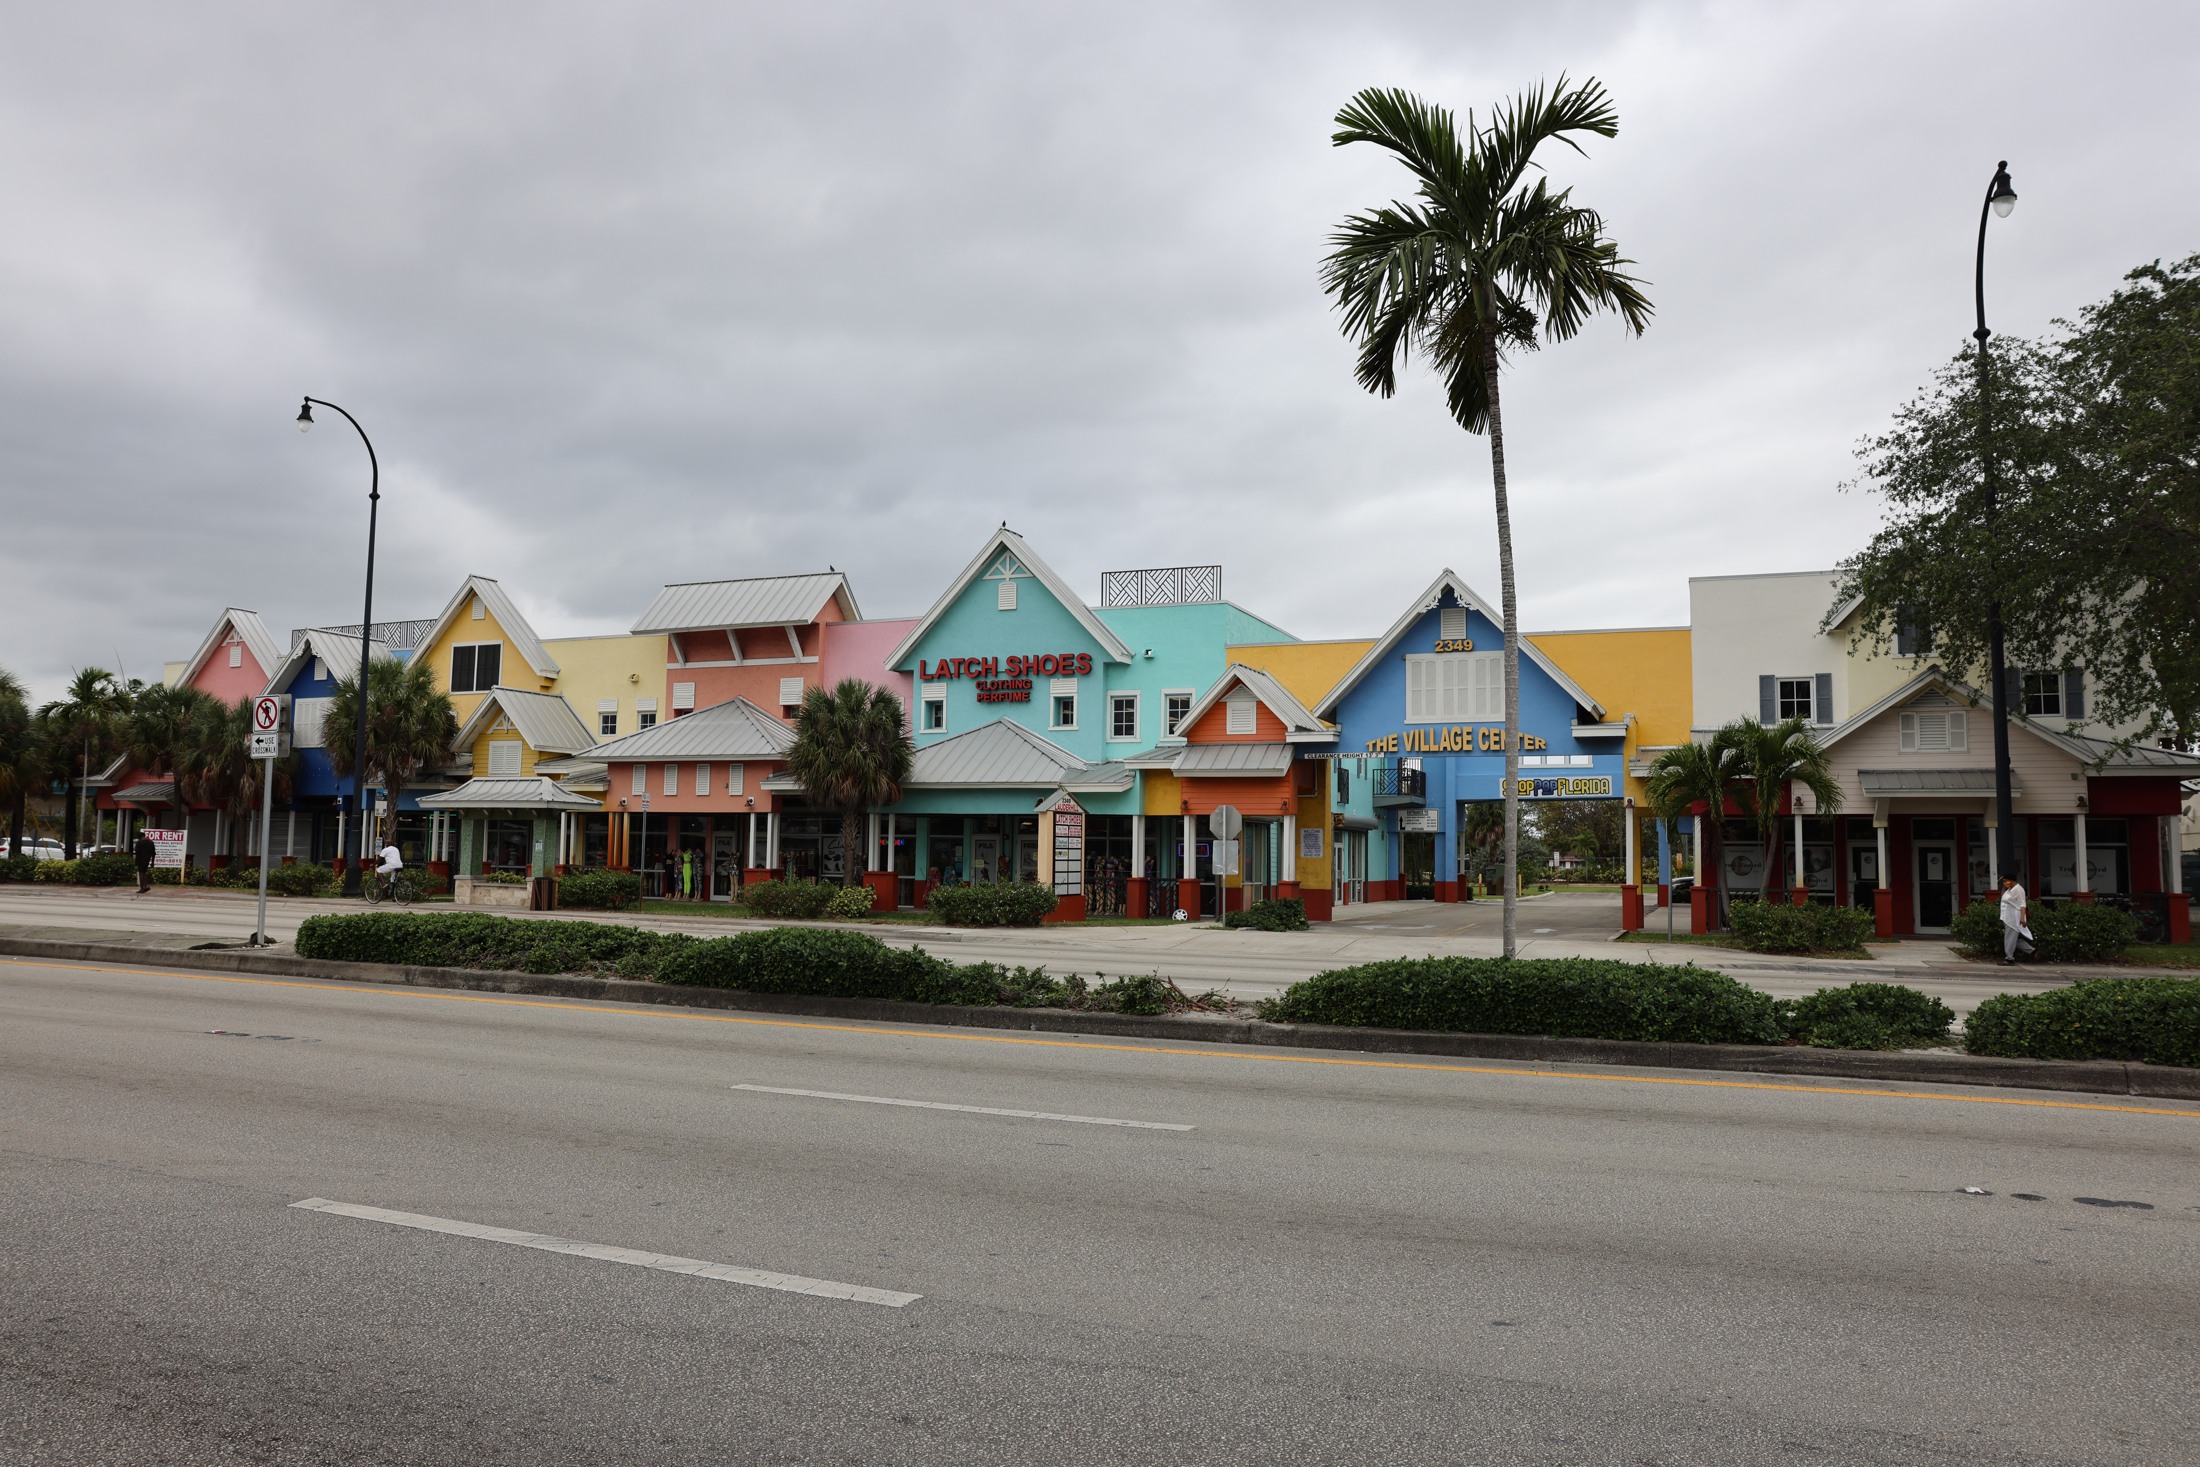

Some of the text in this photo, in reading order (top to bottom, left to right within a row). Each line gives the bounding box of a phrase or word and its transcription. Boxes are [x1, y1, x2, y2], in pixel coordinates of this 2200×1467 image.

[1434, 639, 1473, 652] 2349
[919, 652, 1092, 680] LATCH SHOES
[975, 679, 1032, 691] CLOTHING
[976, 691, 1031, 703] PERFUME
[264, 736, 275, 745] USE
[1365, 733, 1398, 752] THE
[1402, 725, 1473, 752] VILLAGE
[252, 746, 276, 754] CROSSWALK
[144, 831, 183, 841] FOR RENT
